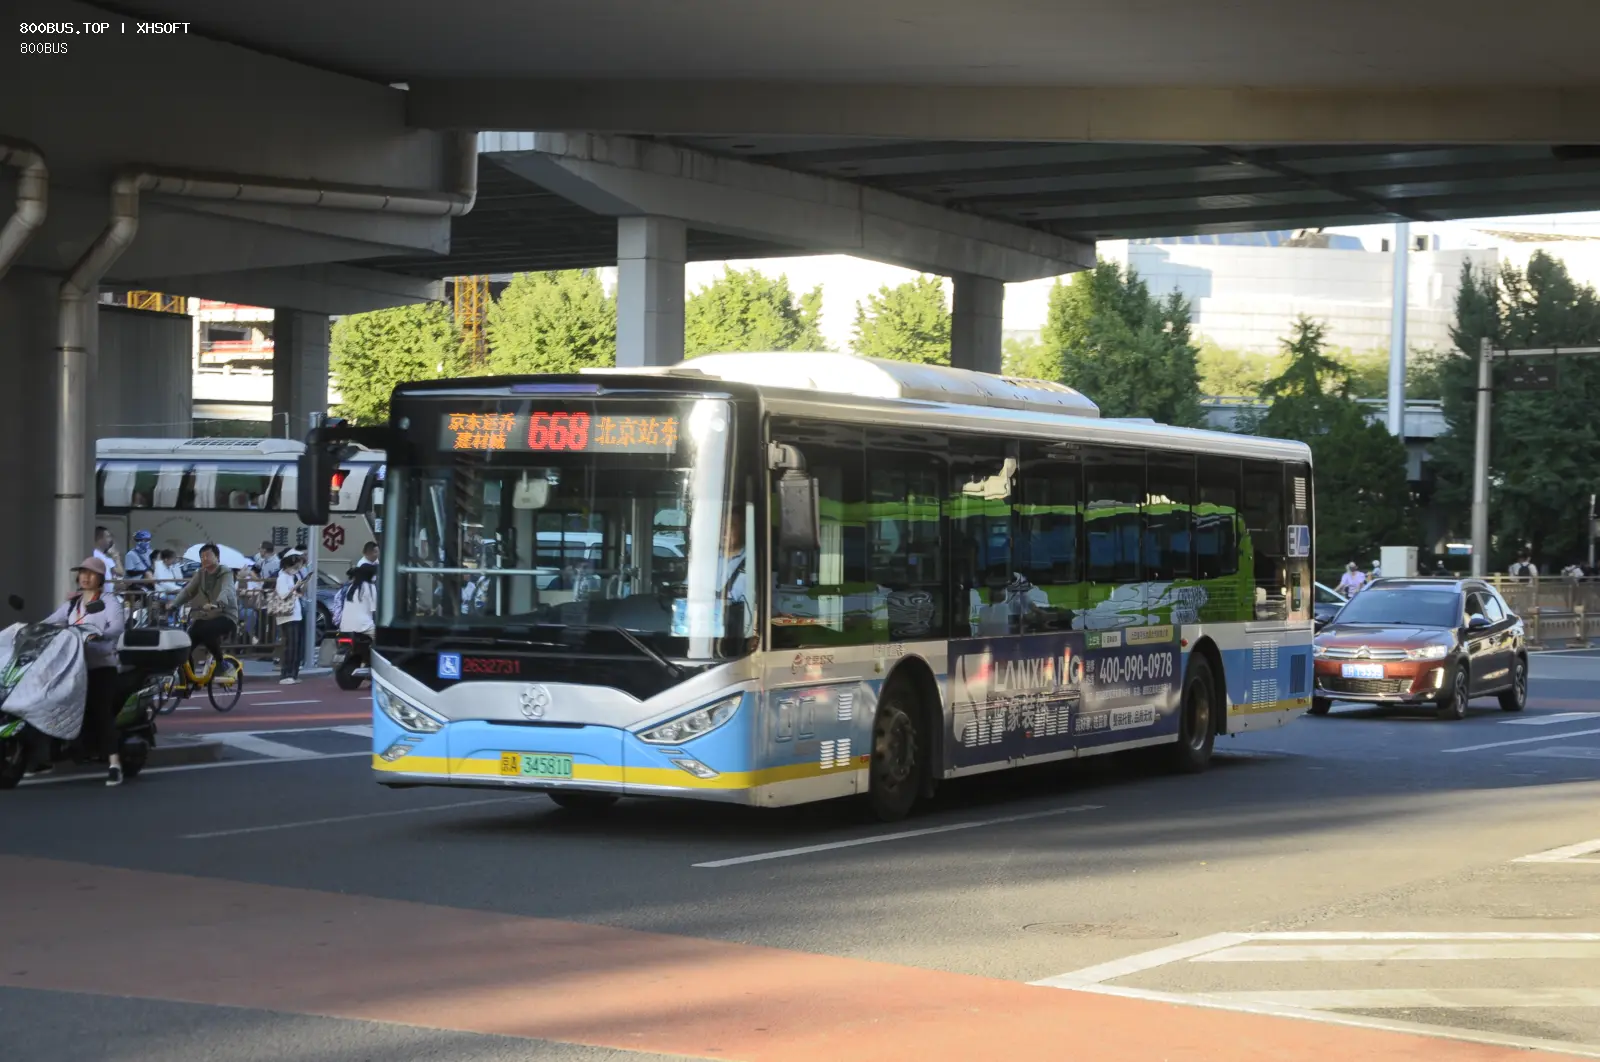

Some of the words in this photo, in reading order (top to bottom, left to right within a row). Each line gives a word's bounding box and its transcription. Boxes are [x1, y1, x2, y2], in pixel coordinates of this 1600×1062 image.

[528, 411, 590, 450] 668
[594, 415, 679, 447] 北京站东
[994, 654, 1083, 693] LANXIANG
[1100, 651, 1172, 684] 400-090-0978
